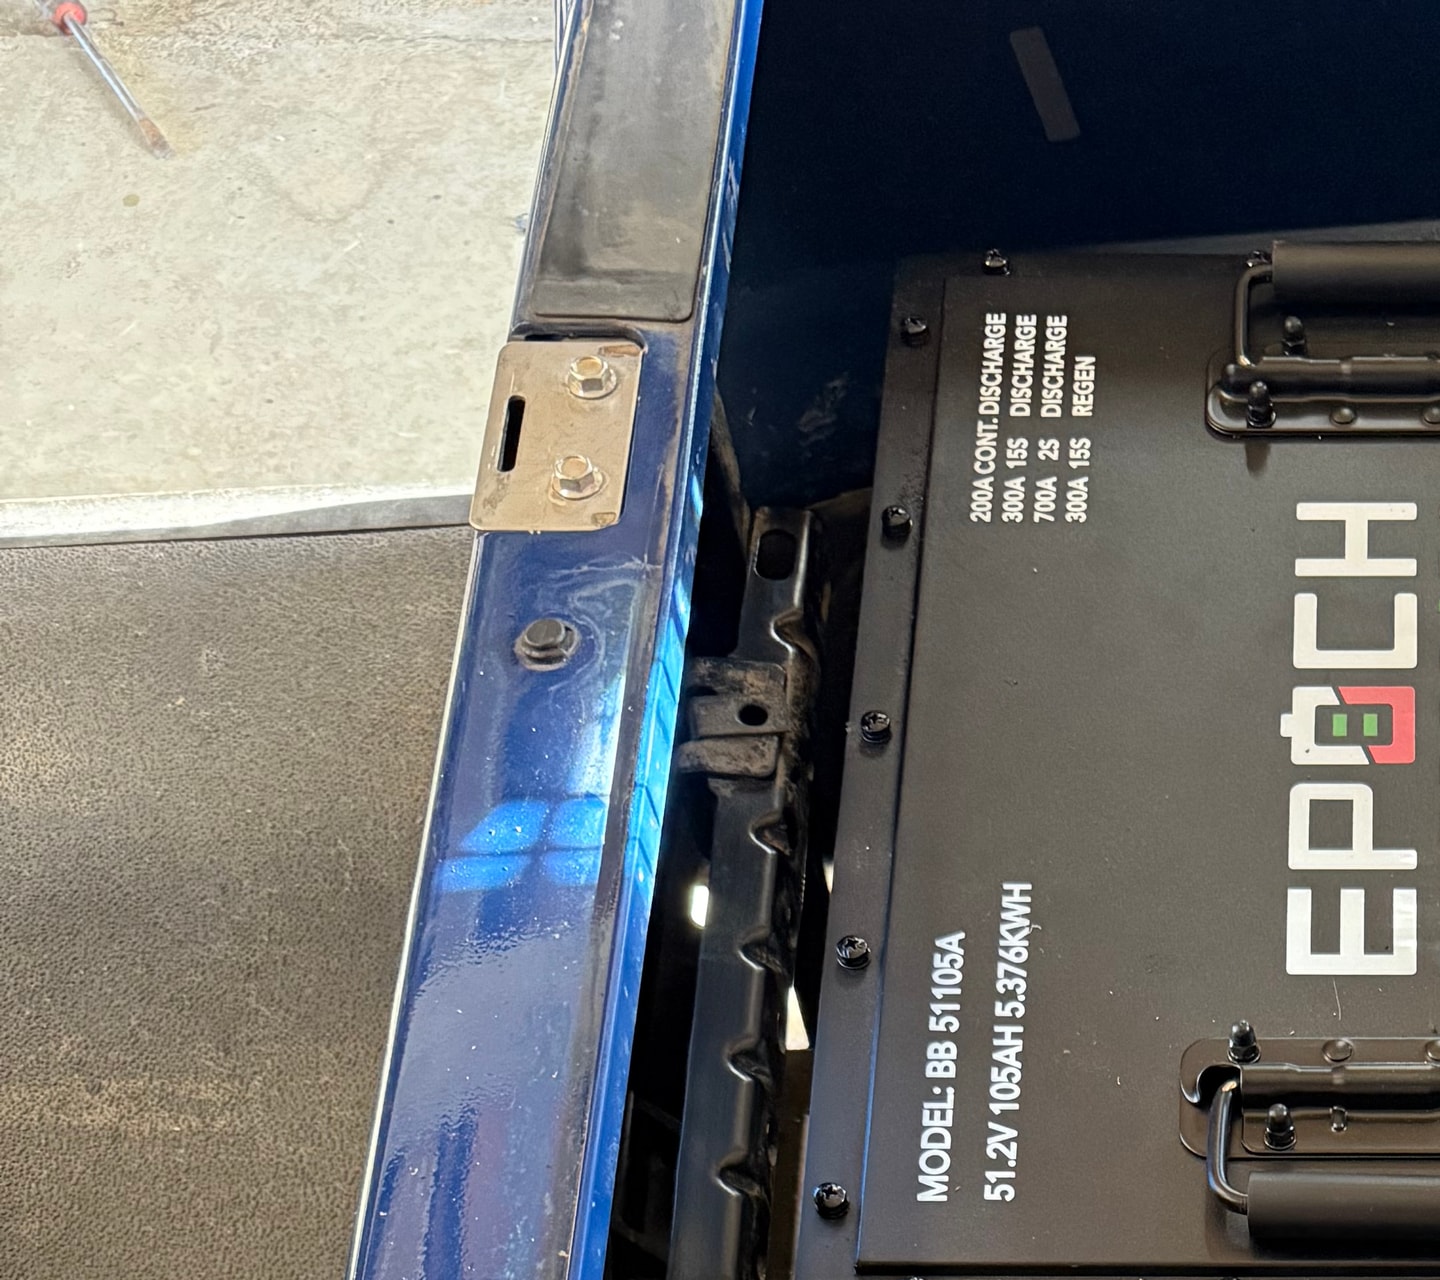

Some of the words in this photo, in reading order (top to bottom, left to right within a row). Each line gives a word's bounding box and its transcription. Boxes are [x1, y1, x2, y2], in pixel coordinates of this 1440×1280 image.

[978, 312, 1007, 415] DISCHARGE
[1009, 314, 1037, 417] DISCHARGE
[1040, 315, 1068, 418] DISCHARGE
[1071, 356, 1096, 417] REGEN
[973, 417, 999, 475] CONT.
[1005, 437, 1029, 470] 15S
[1037, 438, 1061, 461] 2S
[1067, 436, 1092, 470] 15S
[969, 475, 995, 523] 200A
[1001, 475, 1027, 524] 300A
[1032, 475, 1058, 524] 700A
[1064, 475, 1090, 524] 300A
[1279, 501, 1418, 976] EPOCH
[994, 881, 1034, 1019] 5.376KWH
[928, 930, 966, 1034] 51105A
[924, 1040, 958, 1079] BB
[988, 1024, 1025, 1116] 105AH
[916, 1085, 956, 1202] MODEL:
[983, 1120, 1019, 1202] 51.2V
